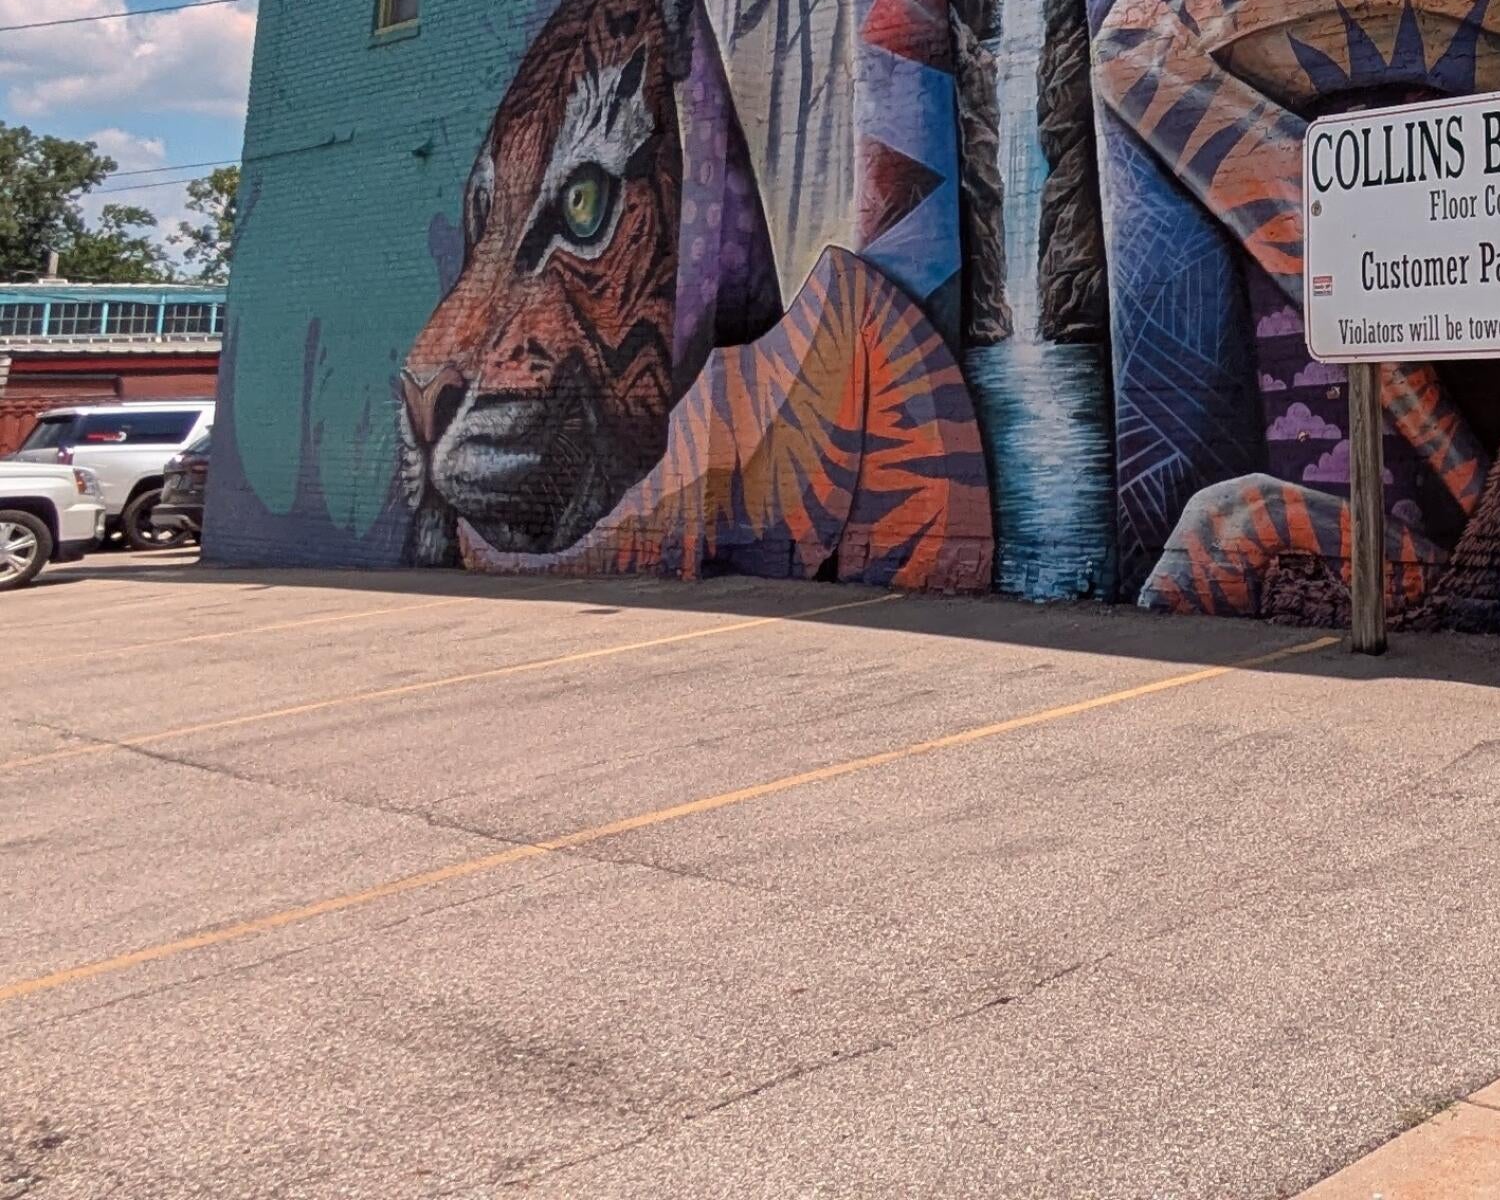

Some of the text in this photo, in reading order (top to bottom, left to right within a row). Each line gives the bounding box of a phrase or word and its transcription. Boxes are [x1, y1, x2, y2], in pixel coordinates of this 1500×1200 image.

[1311, 115, 1465, 193] COLLINS
[1429, 189, 1478, 221] Floor
[1362, 251, 1470, 291] Customer
[1338, 318, 1404, 345] Violators
[1408, 314, 1440, 342] will
[1445, 313, 1463, 341] be
